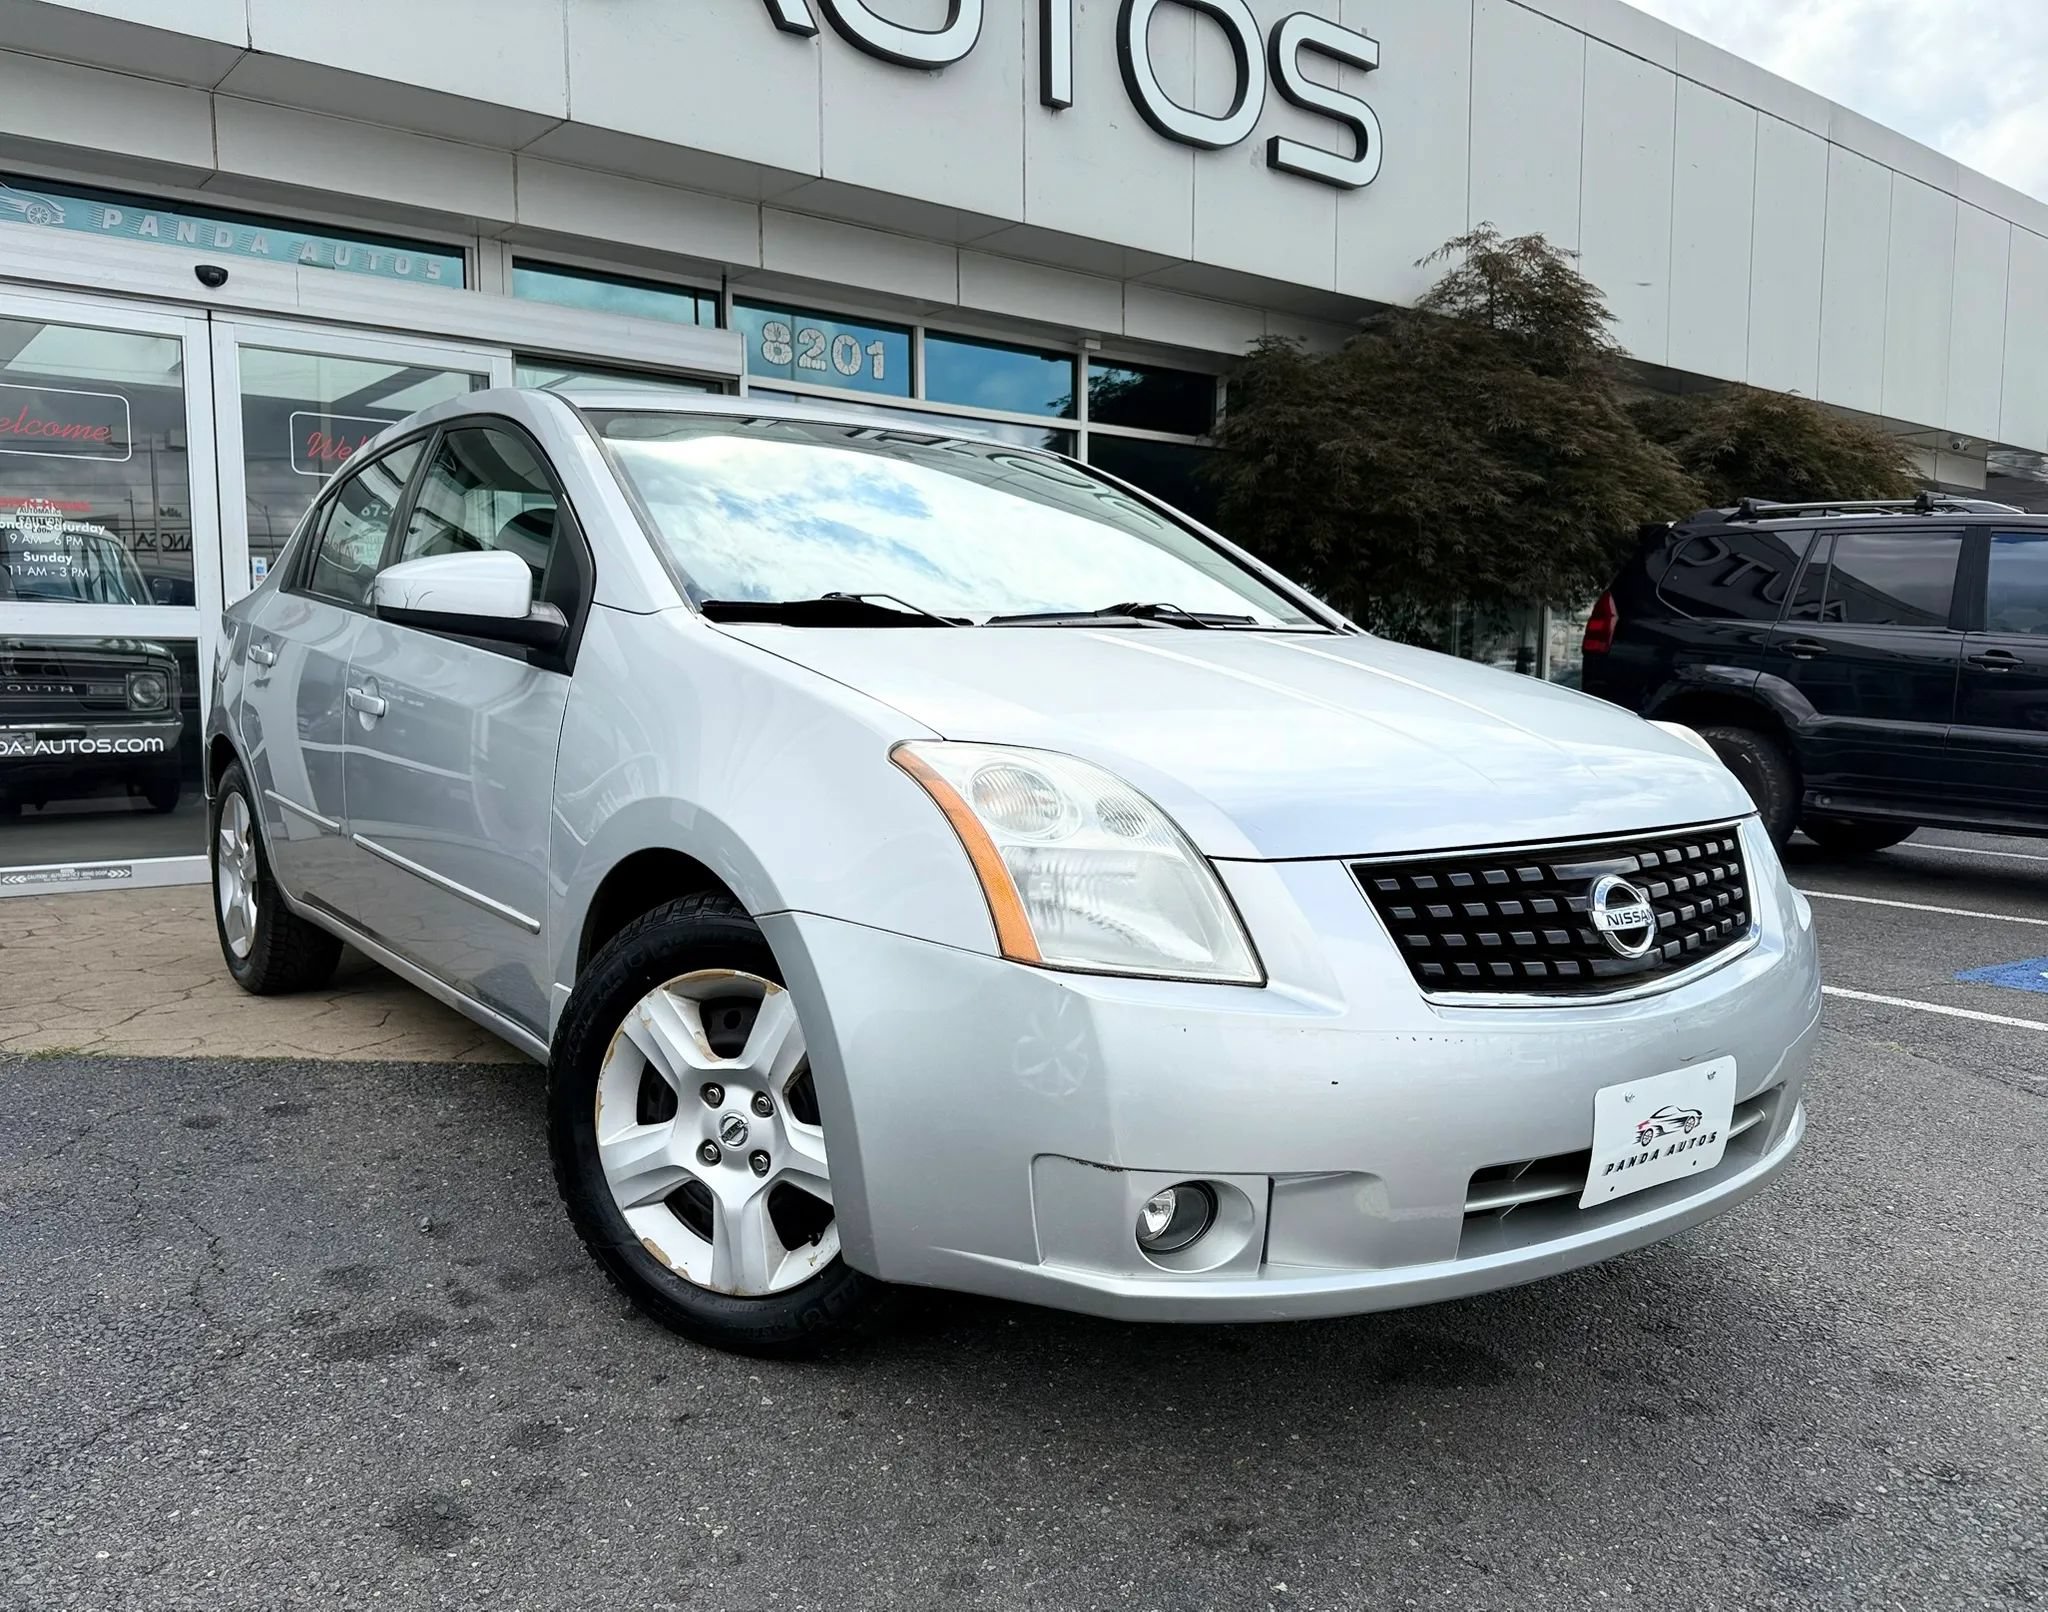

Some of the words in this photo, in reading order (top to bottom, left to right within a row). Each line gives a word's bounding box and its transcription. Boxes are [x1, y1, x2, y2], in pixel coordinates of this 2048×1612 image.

[102, 207, 269, 254] PANDA
[299, 240, 441, 280] AUTOS
[761, 320, 885, 380] 8201
[0, 403, 112, 440] elcome
[10, 533, 18, 544] 9
[22, 535, 41, 545] AM
[55, 535, 62, 546] 6
[66, 536, 84, 547] PM
[23, 551, 73, 565] Sunday
[9, 565, 22, 576] 11
[27, 566, 47, 577] AM
[60, 567, 67, 577] 3
[71, 567, 90, 578] PM
[1604, 1148, 1660, 1176] PANDA
[1665, 1131, 1717, 1157] AUTOS
